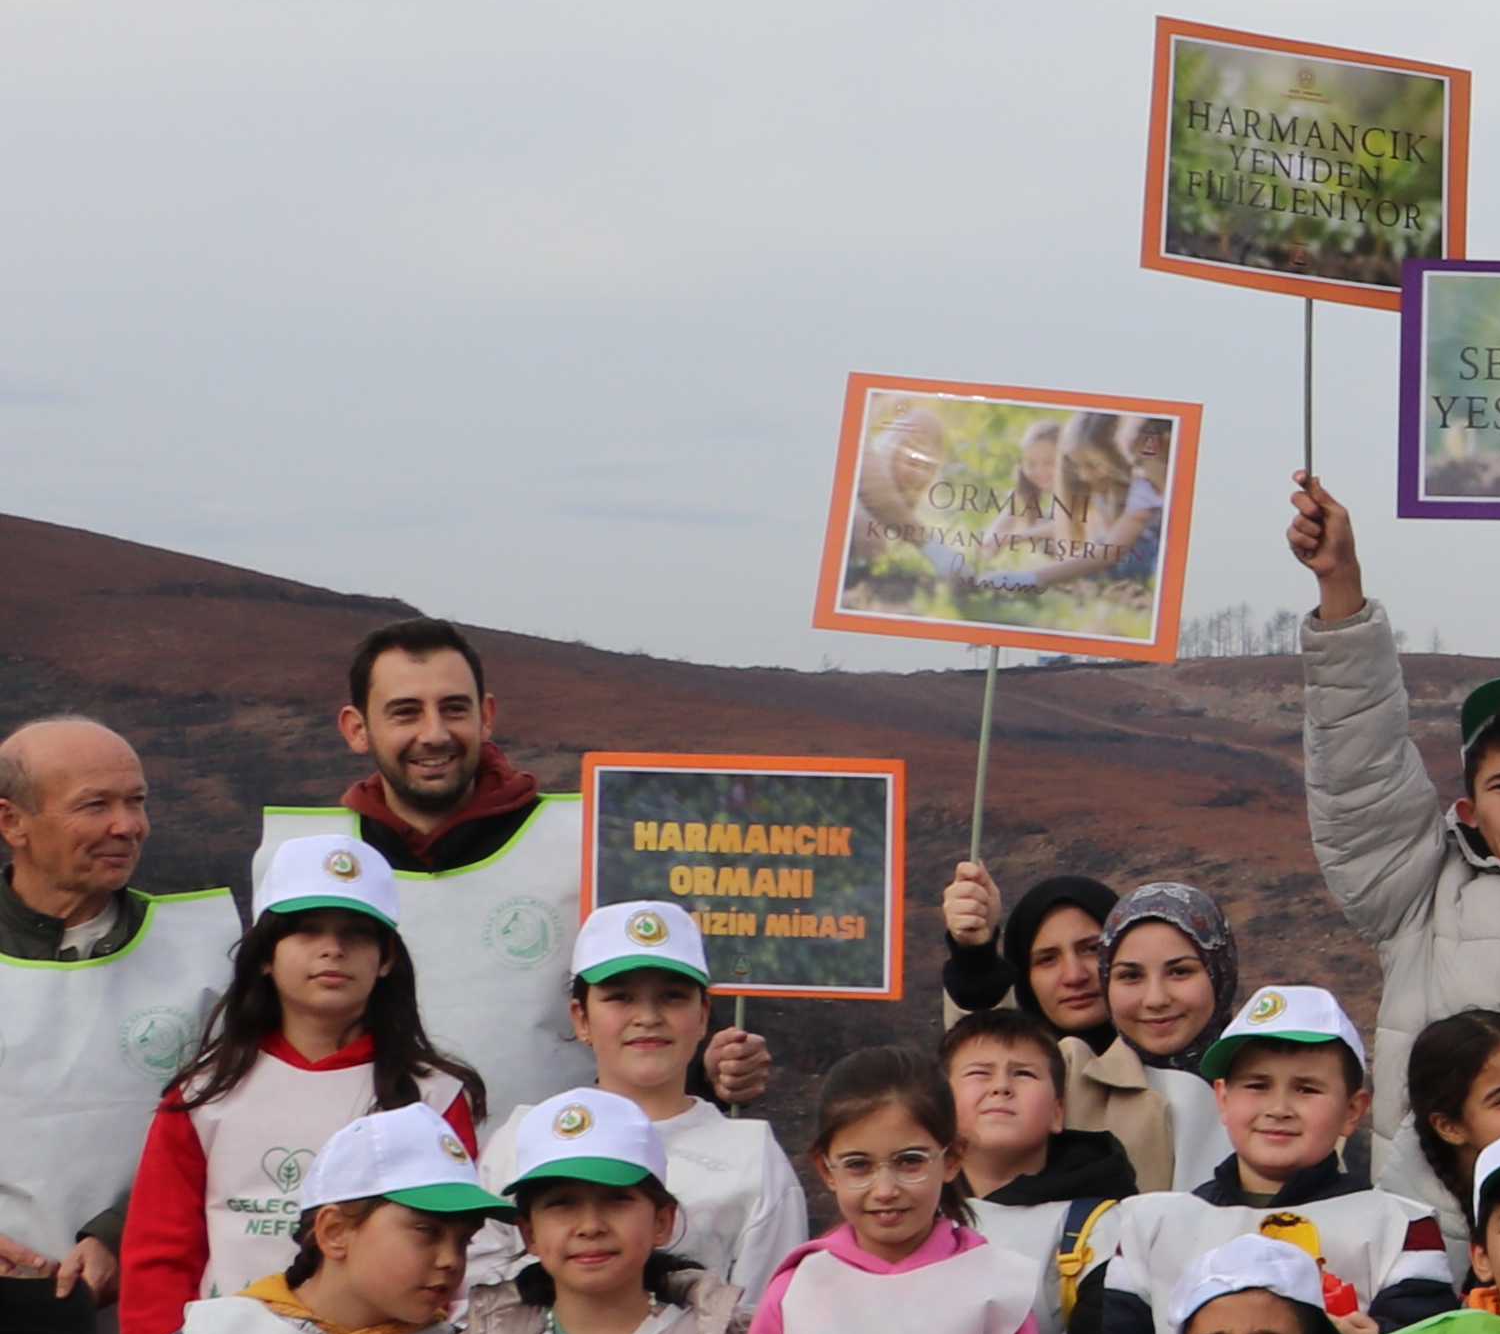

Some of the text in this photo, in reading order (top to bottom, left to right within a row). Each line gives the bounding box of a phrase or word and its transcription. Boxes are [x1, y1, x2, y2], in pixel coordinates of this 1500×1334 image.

[1187, 99, 1428, 164] HARMANCIK
[1229, 142, 1381, 192] YENİDEN
[1187, 170, 1424, 231] FİLİZLENİYOR
[929, 480, 1091, 524] ORMANI
[867, 520, 986, 549] KORUYAN
[948, 553, 1049, 597] benim
[633, 820, 852, 856] HARMANCIK
[668, 865, 814, 899] ORMANI
[763, 908, 867, 940] MİRASI
[226, 1198, 300, 1216] GELEC
